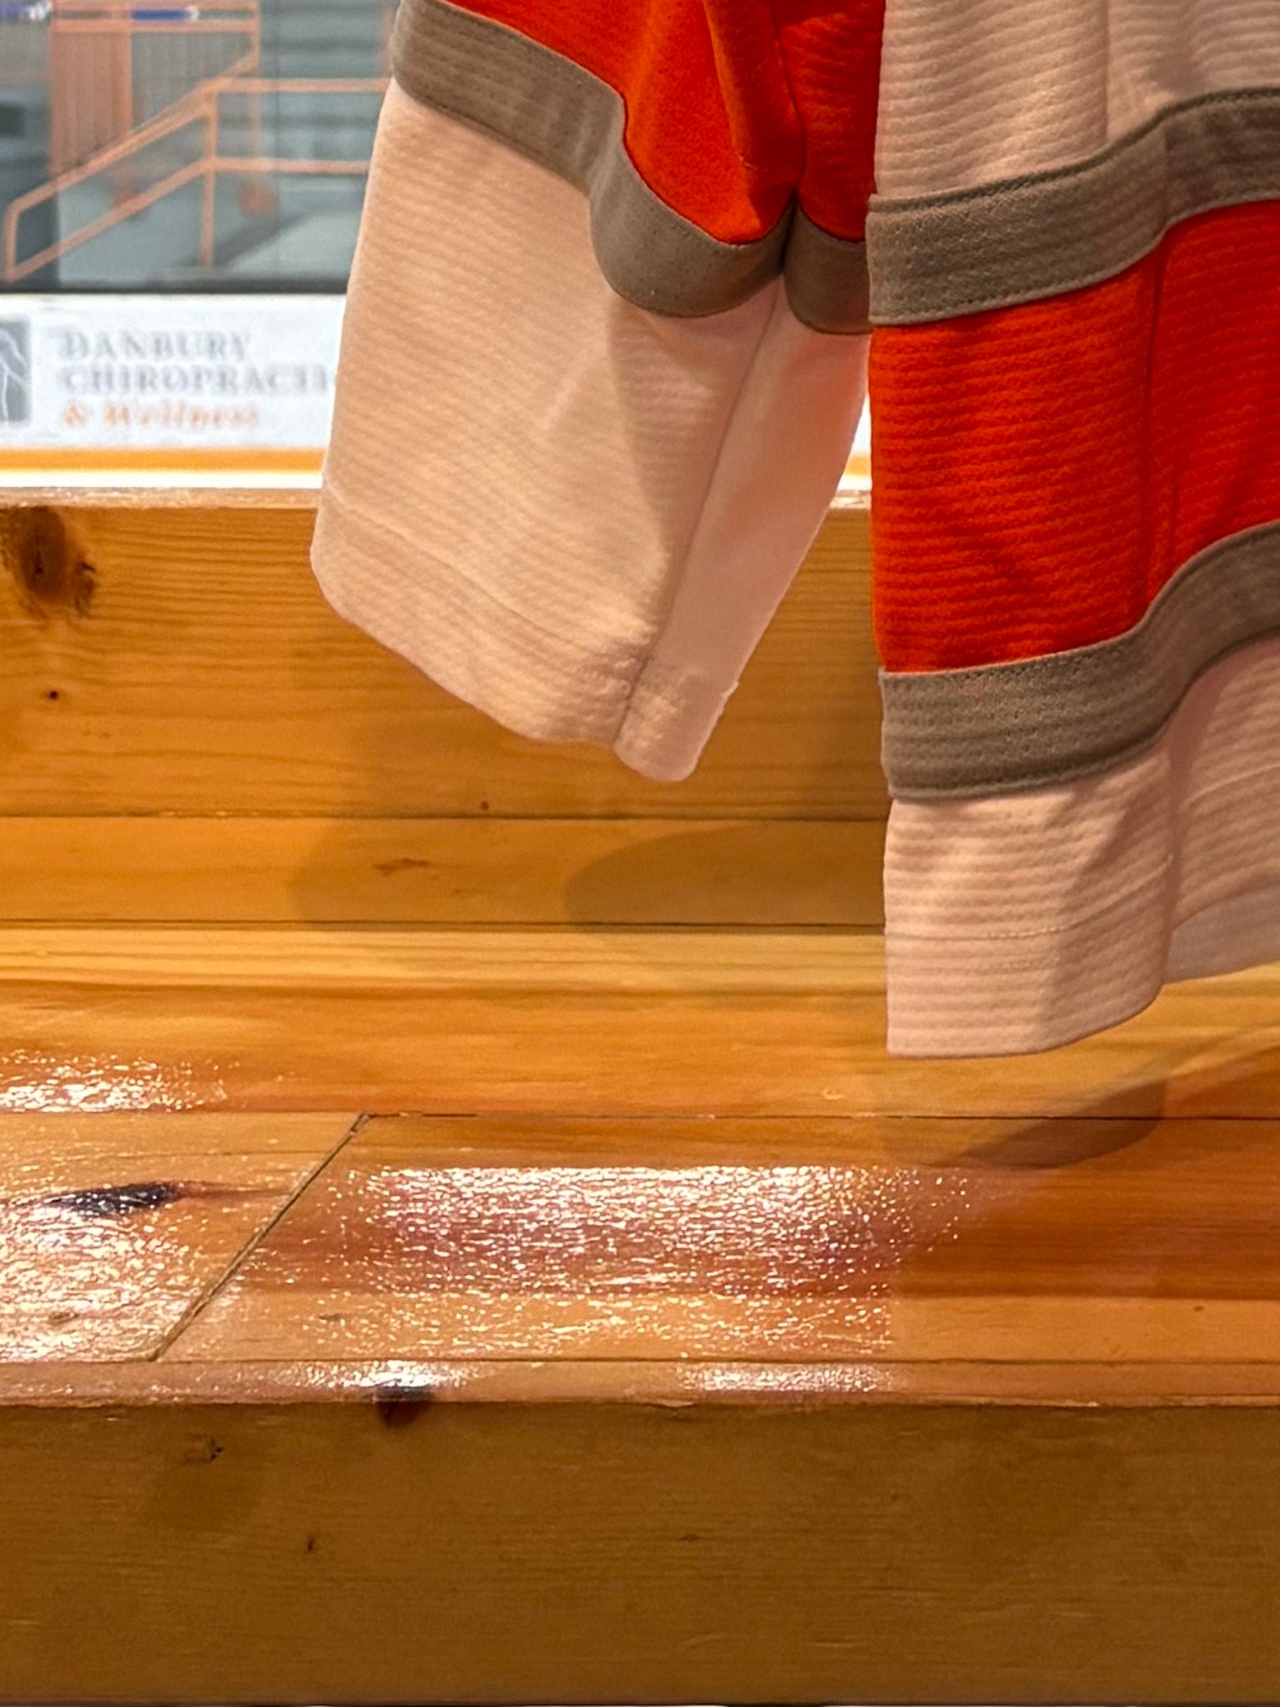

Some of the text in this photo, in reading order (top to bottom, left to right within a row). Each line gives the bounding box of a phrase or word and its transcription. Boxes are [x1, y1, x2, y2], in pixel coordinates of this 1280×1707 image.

[59, 330, 250, 360] DANBURY
[59, 363, 329, 395] CHIROPRACTI
[103, 399, 259, 427] Wellness
